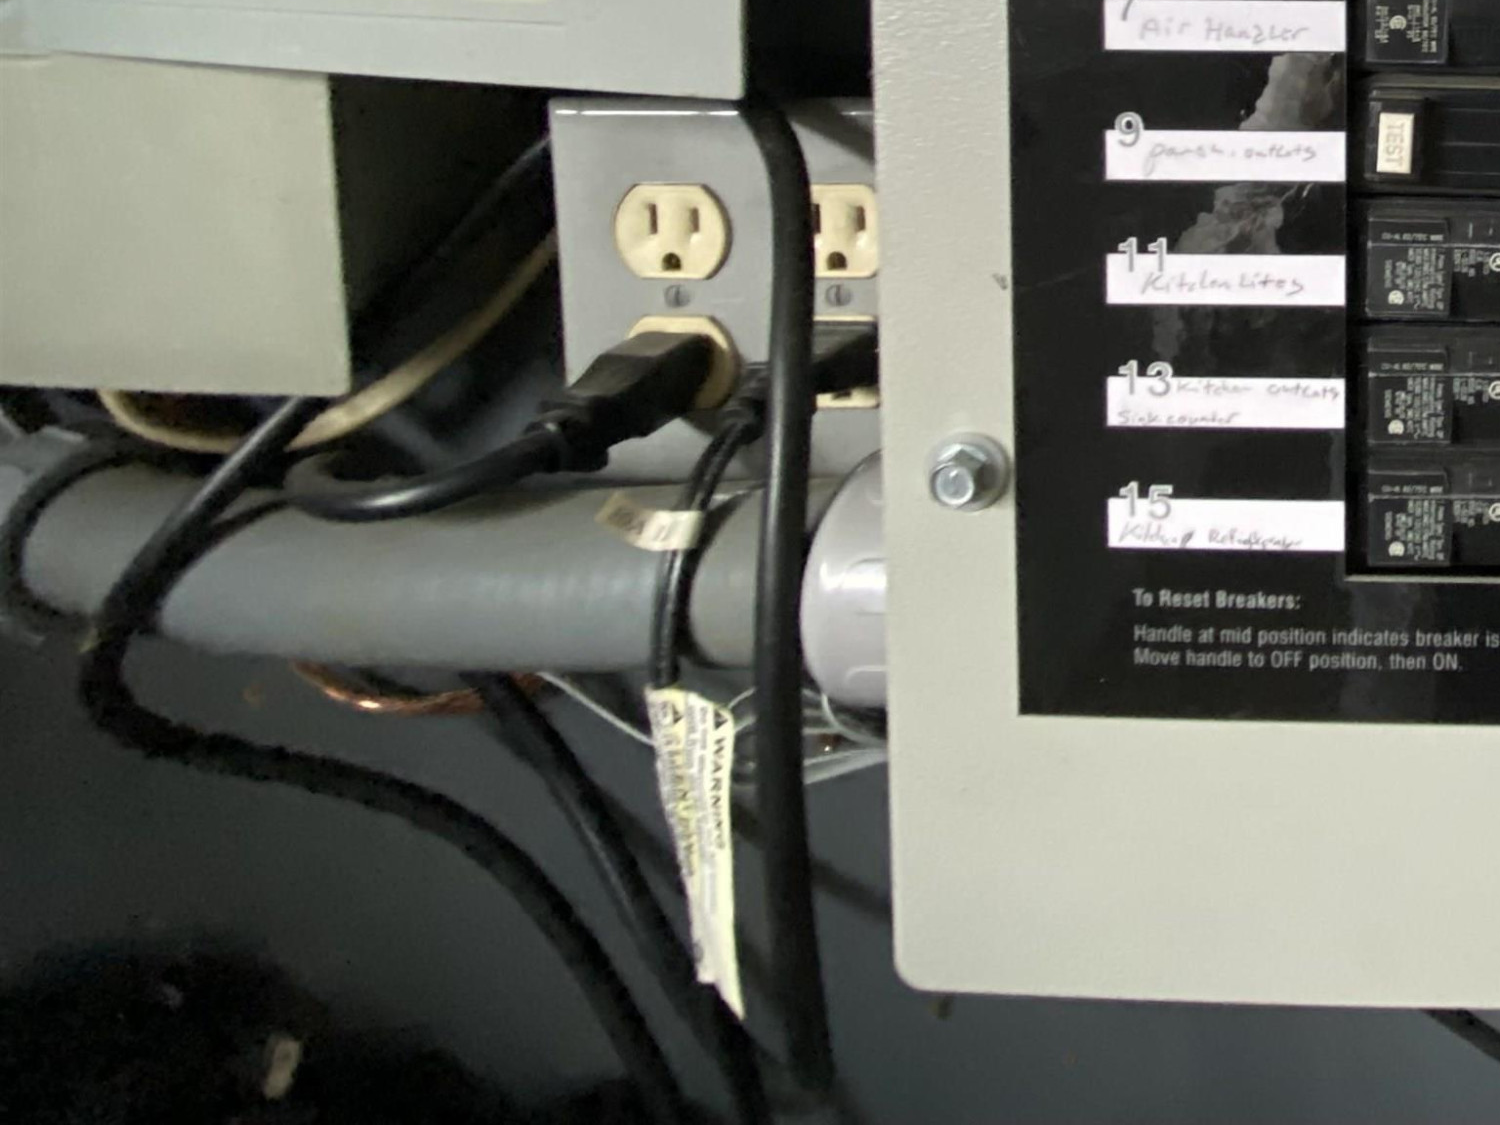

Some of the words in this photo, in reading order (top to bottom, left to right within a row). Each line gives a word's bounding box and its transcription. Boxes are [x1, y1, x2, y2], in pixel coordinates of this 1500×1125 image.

[1114, 111, 1145, 148] 9
[1385, 122, 1405, 166] TEST
[1118, 237, 1167, 273] 11
[1118, 360, 1173, 396] 13
[1119, 481, 1174, 520] 15
[1132, 589, 1153, 608] To
[1159, 589, 1210, 609] Reset
[1215, 589, 1301, 610] Breakers:
[1133, 625, 1192, 645] Handle
[1198, 627, 1215, 644] at
[1220, 626, 1252, 645] mid
[1257, 627, 1326, 648] position
[1332, 627, 1409, 647] indicates
[1415, 628, 1479, 648] breaker
[1485, 630, 1500, 648] is
[1133, 647, 1180, 667] Move
[1185, 648, 1243, 668] handle
[1247, 650, 1265, 668] to
[1270, 651, 1301, 669] OFF
[1309, 651, 1383, 672] position,
[1389, 652, 1427, 670] then
